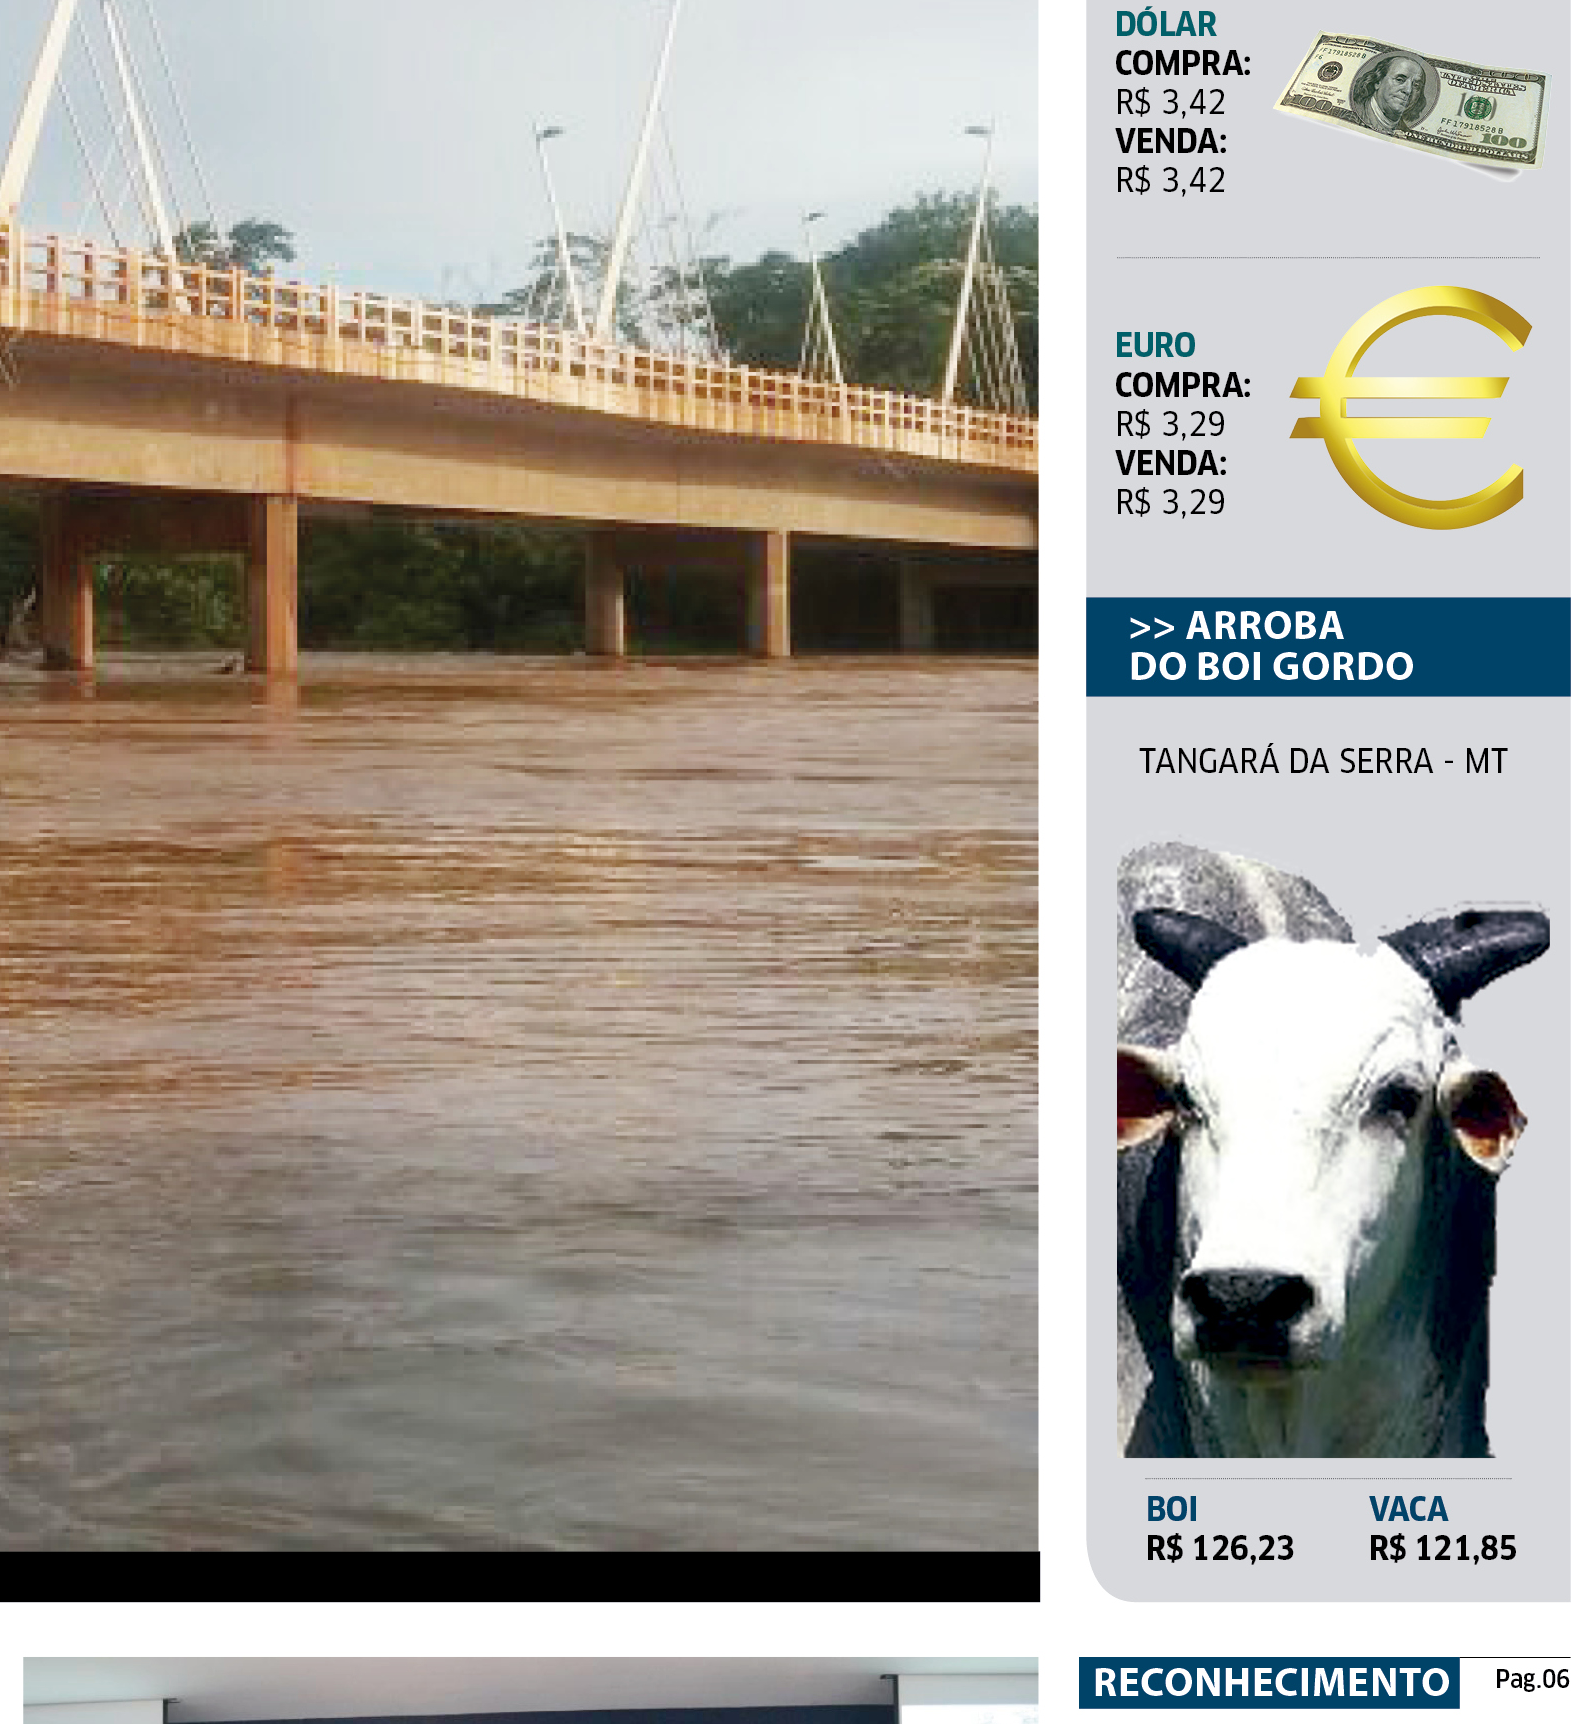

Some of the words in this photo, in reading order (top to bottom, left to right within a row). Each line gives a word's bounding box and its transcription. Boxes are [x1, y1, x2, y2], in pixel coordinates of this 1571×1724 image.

[1116, 5, 1218, 37] DÓLAR
[1115, 49, 1251, 76] COMPRA:
[1117, 86, 1151, 118] R$
[1162, 88, 1225, 120] 3,42
[1114, 127, 1227, 154] VENDA:
[1479, 132, 1528, 149] 100
[1117, 164, 1151, 196] R$
[1162, 166, 1225, 198] 3,42
[1185, 610, 1345, 640] ARROBA
[1130, 651, 1187, 681] DO
[1197, 651, 1261, 681] BOI
[1272, 651, 1414, 681] GORDO
[1147, 1495, 1197, 1522] BOI
[1368, 1495, 1450, 1522] VACA
[1147, 1532, 1184, 1564] R$
[1193, 1534, 1294, 1566] 126,23
[1370, 1532, 1407, 1564] R$
[1416, 1534, 1517, 1566] 121,85
[1094, 1667, 1450, 1697] RECONHECIMENTO
[1496, 1668, 1570, 1693] Pag.06
